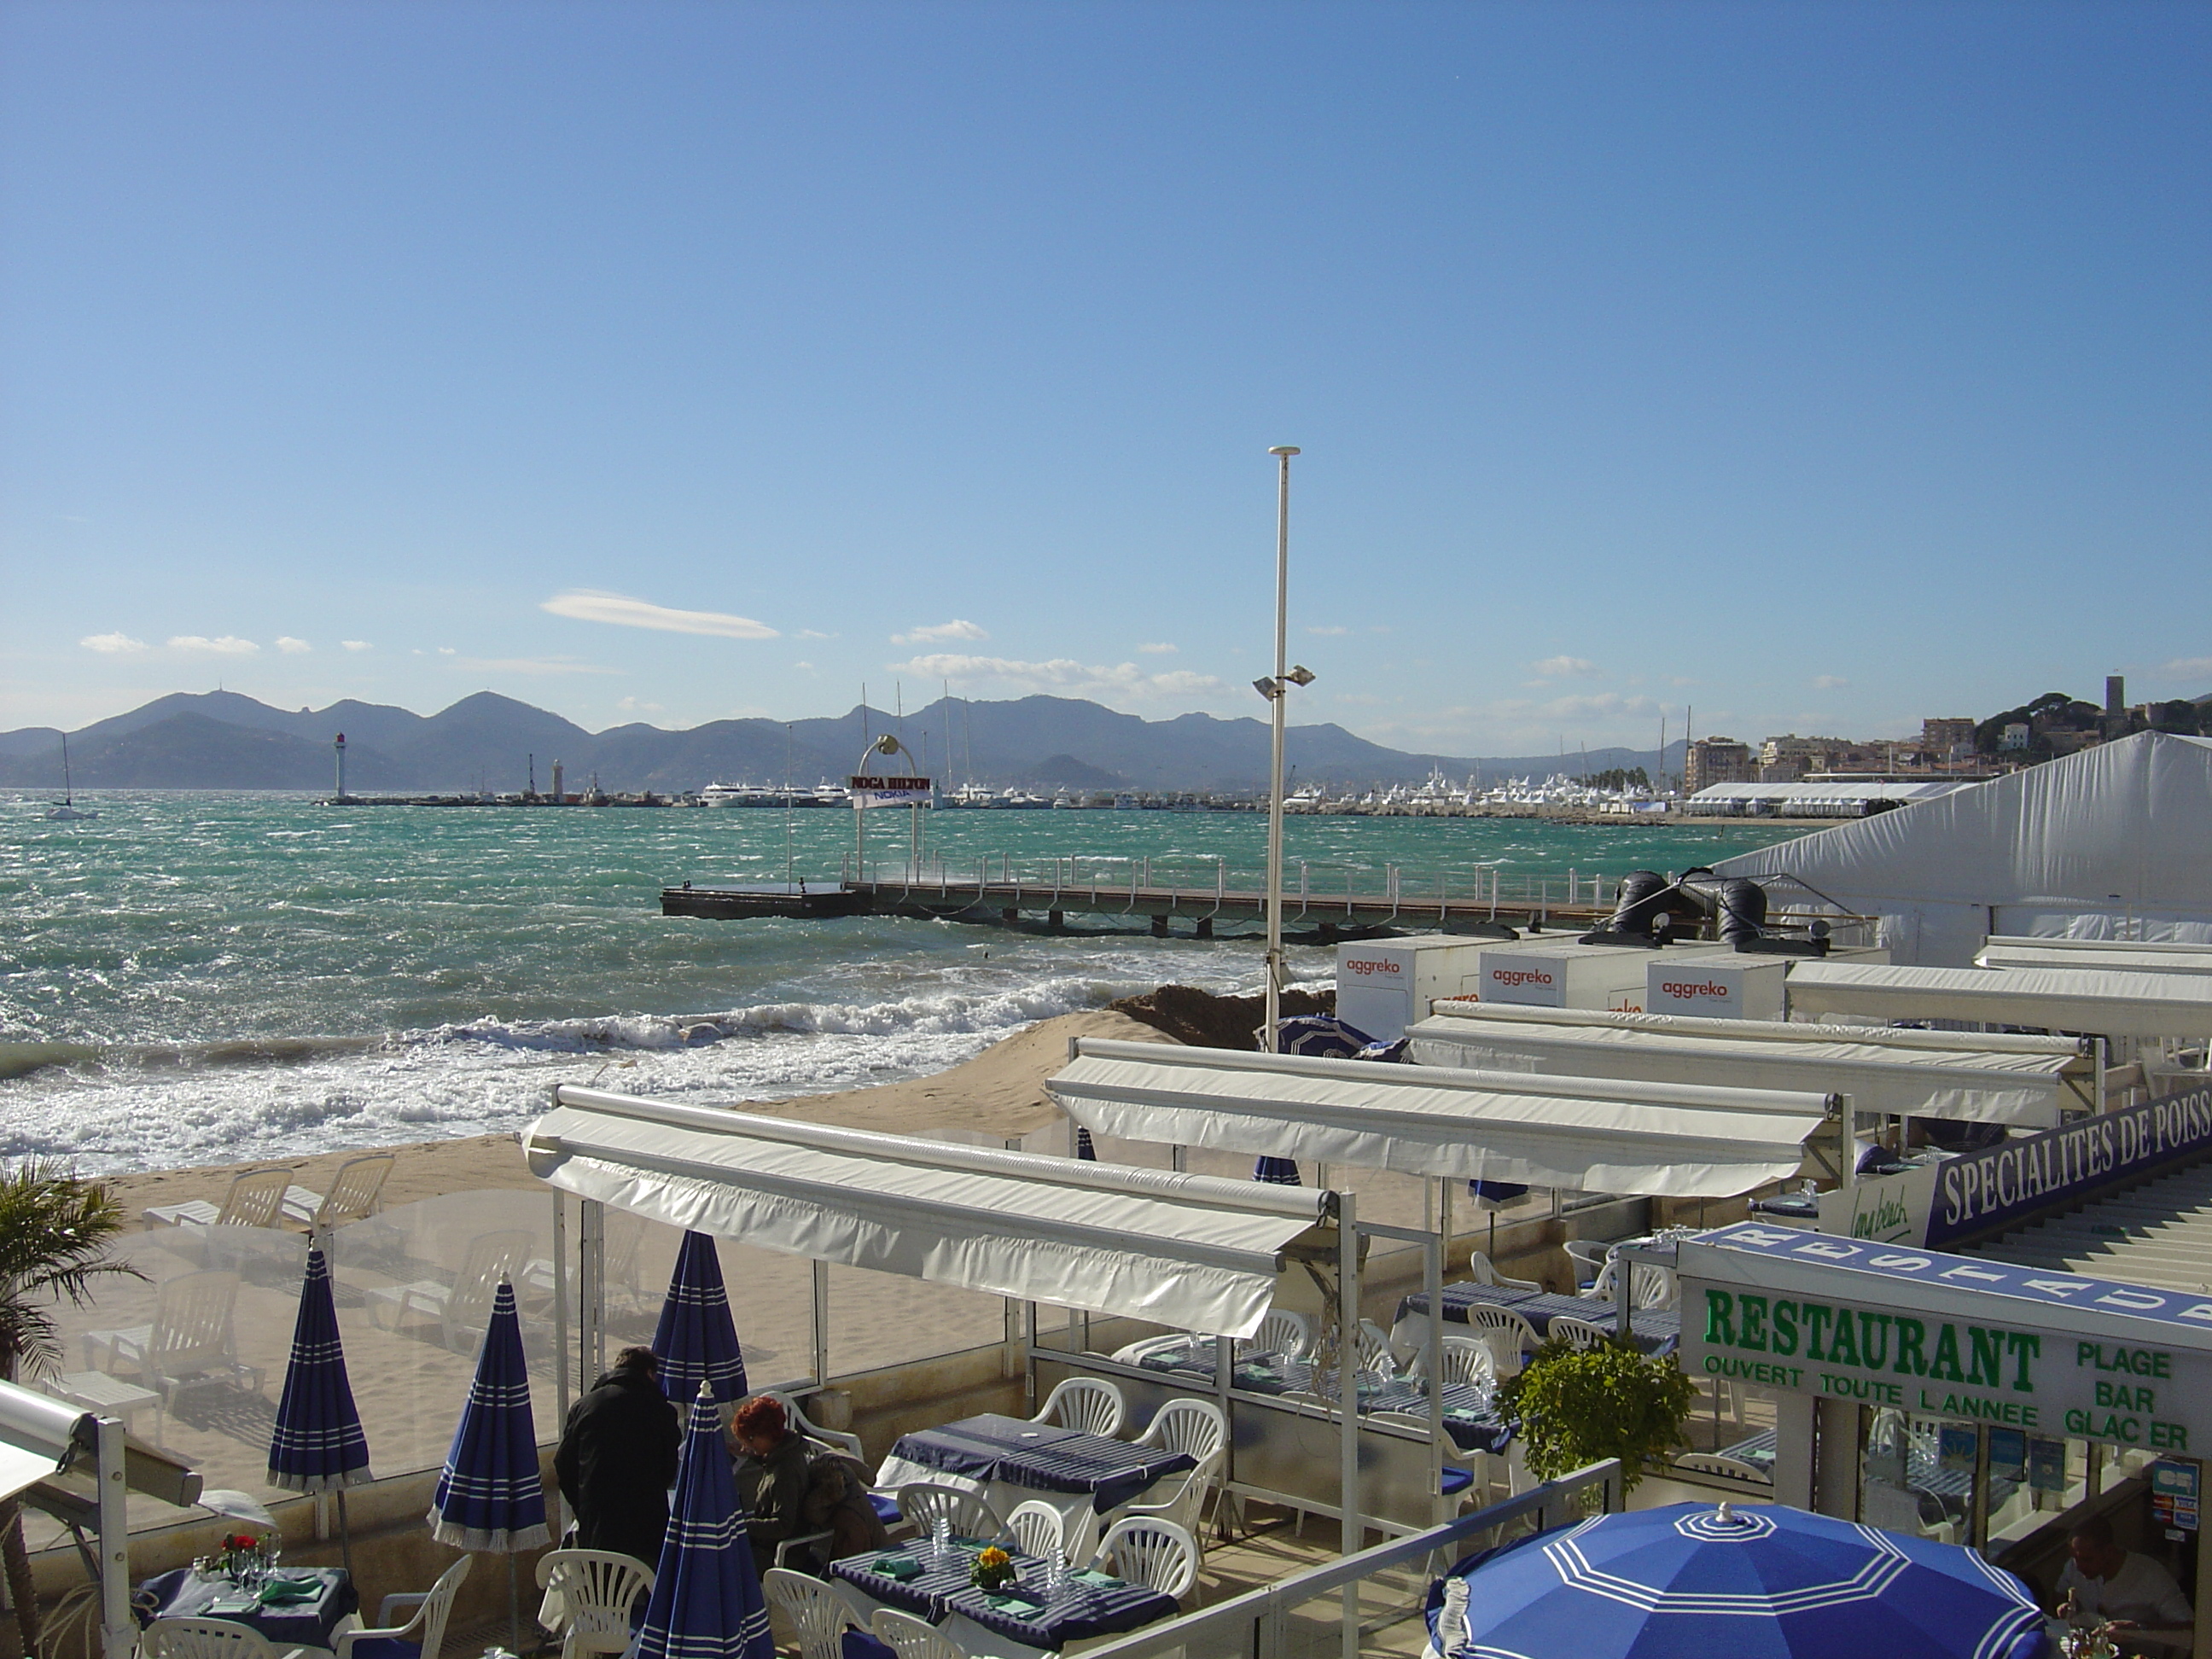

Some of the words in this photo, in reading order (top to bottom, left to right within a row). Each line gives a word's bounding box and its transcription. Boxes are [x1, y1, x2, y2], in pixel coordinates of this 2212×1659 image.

[852, 776, 885, 789] NOGA
[888, 777, 930, 790] HILTON
[874, 790, 911, 800] NOKIA
[1347, 958, 1400, 975] aggreko
[1493, 969, 1552, 986] aggreko
[1662, 981, 1727, 999] aggreko
[1945, 1119, 2114, 1226] SPECIALITES
[2119, 1109, 2151, 1166] DE
[2155, 1090, 2212, 1153] POISS
[1703, 1289, 2040, 1393] RESTAURANT
[2077, 1342, 2171, 1379] PLAGE
[1703, 1354, 1804, 1388] OUVERT
[1819, 1373, 1903, 1405] TOUTE
[1942, 1394, 2039, 1427] ANNEE
[2095, 1381, 2155, 1413] BAR
